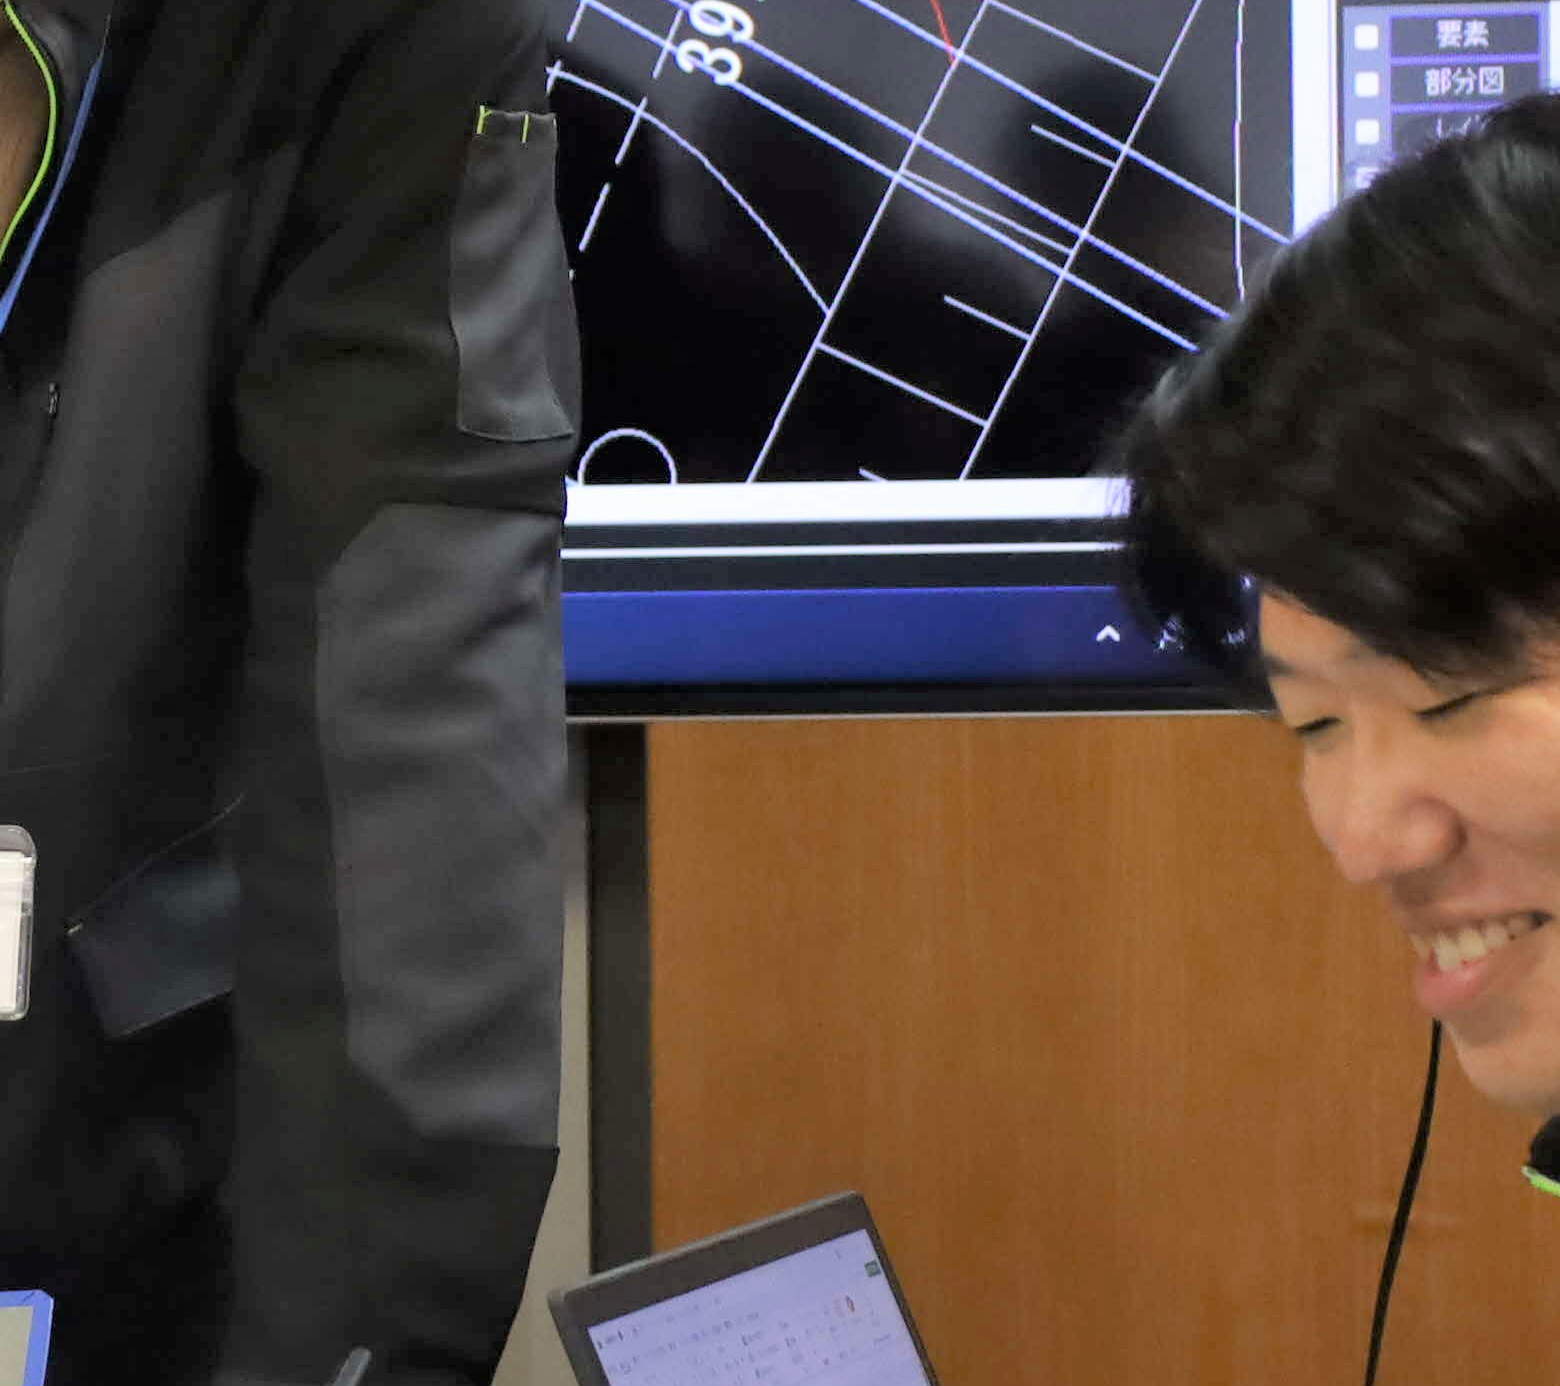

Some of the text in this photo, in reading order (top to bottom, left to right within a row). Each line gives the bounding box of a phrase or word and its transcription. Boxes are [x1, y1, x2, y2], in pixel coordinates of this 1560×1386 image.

[1436, 19, 1489, 49] 要素
[1425, 66, 1505, 96] 部分図
